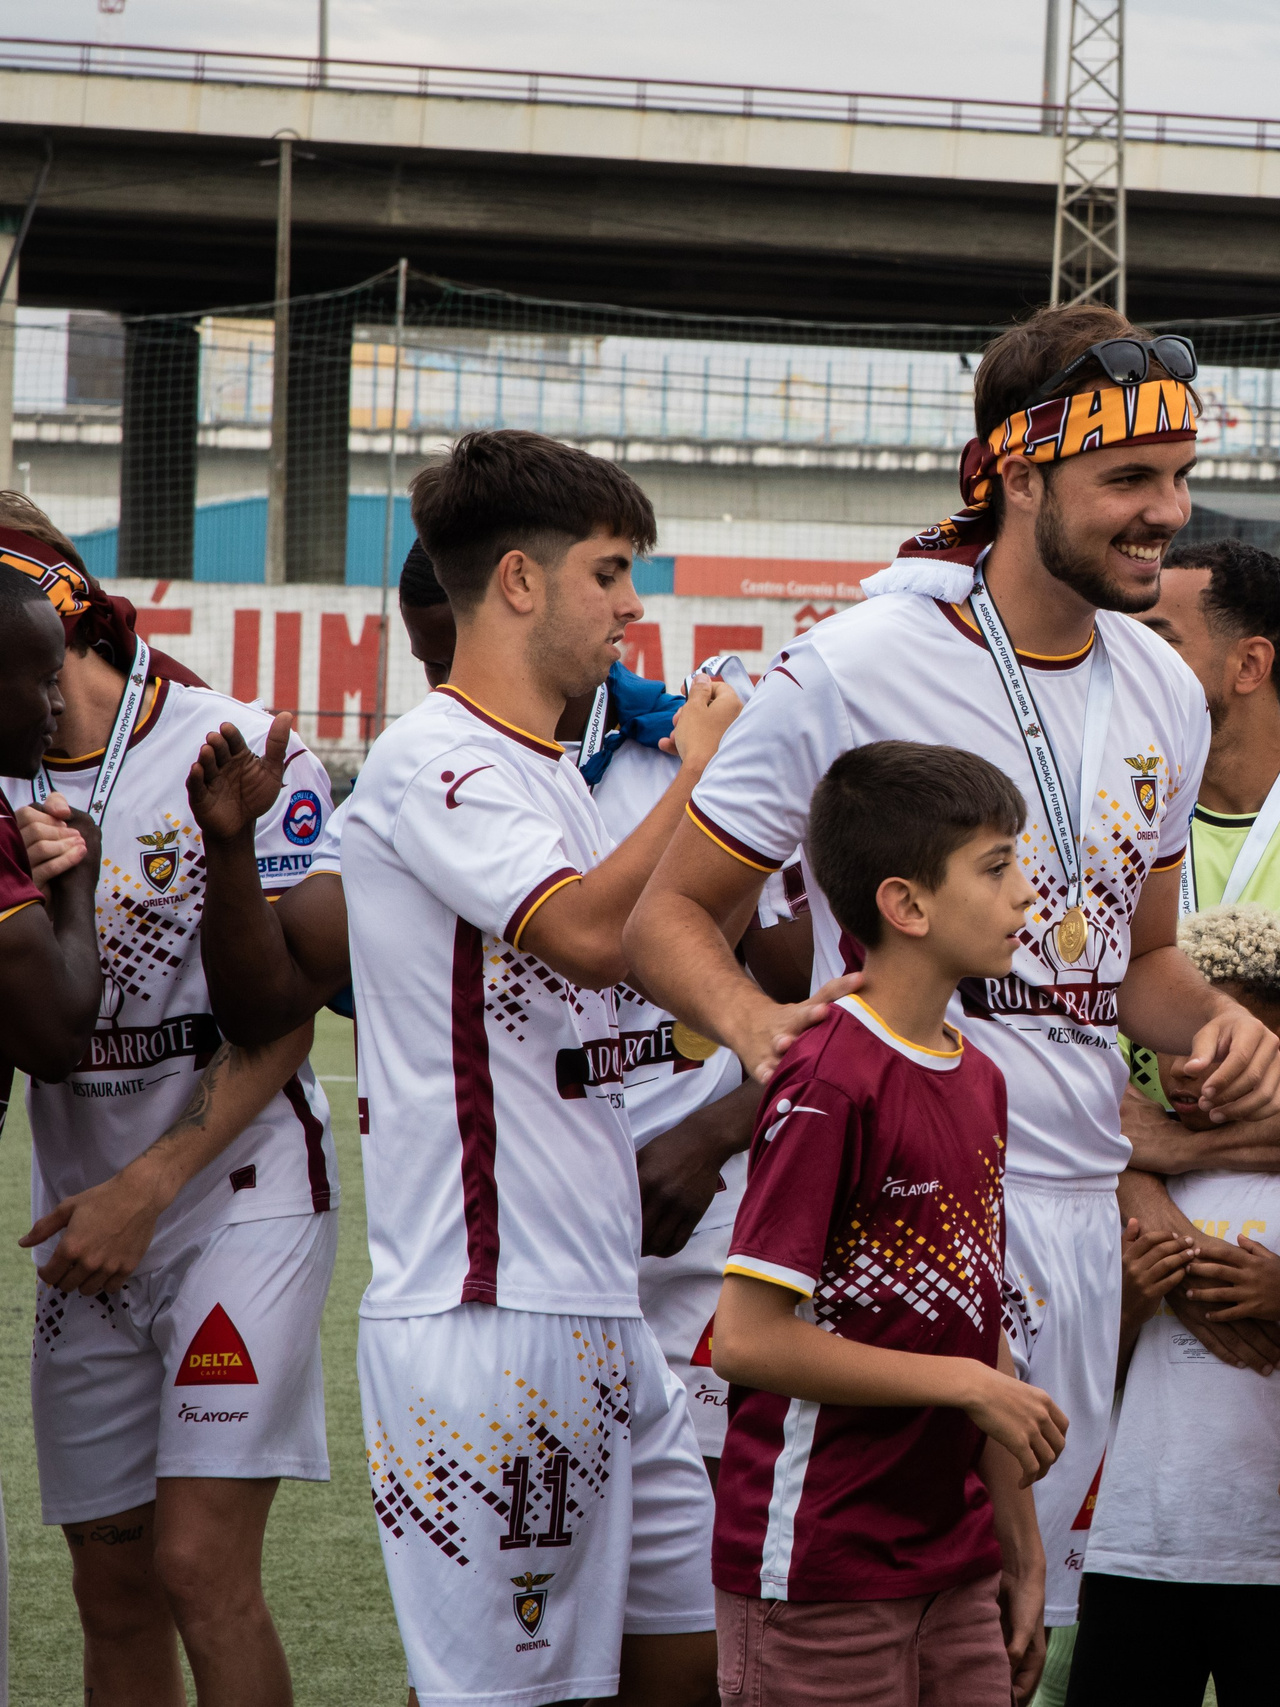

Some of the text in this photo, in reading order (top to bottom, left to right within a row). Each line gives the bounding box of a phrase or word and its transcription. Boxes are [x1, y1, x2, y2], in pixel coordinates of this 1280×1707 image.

[740, 578, 786, 595] Centro
[836, 582, 865, 600] Emp
[979, 602, 1030, 717] ASSOCIAÇÃO FUTEBOL DE LISBOA
[587, 717, 601, 759] ASSOCIAÇÃO
[595, 690, 606, 719] FUTEBOL
[99, 691, 137, 794] ASSOCIAÇÃO FUTEBOL DE LISBOA
[1035, 746, 1073, 866] ASSOCIAÇÃO FUTEBOL DE LISBOA
[1136, 830, 1159, 841] ORIENTA
[142, 894, 186, 908] ORIENTAL
[984, 977, 1033, 1010] RUI
[90, 1019, 194, 1066] BARROTE
[71, 1078, 146, 1098] RESTAURANTE
[189, 1352, 244, 1368] DELTA
[184, 1411, 250, 1423] PLAYOFF
[500, 1454, 573, 1551] 11
[515, 1638, 551, 1653] ORIENTAL
